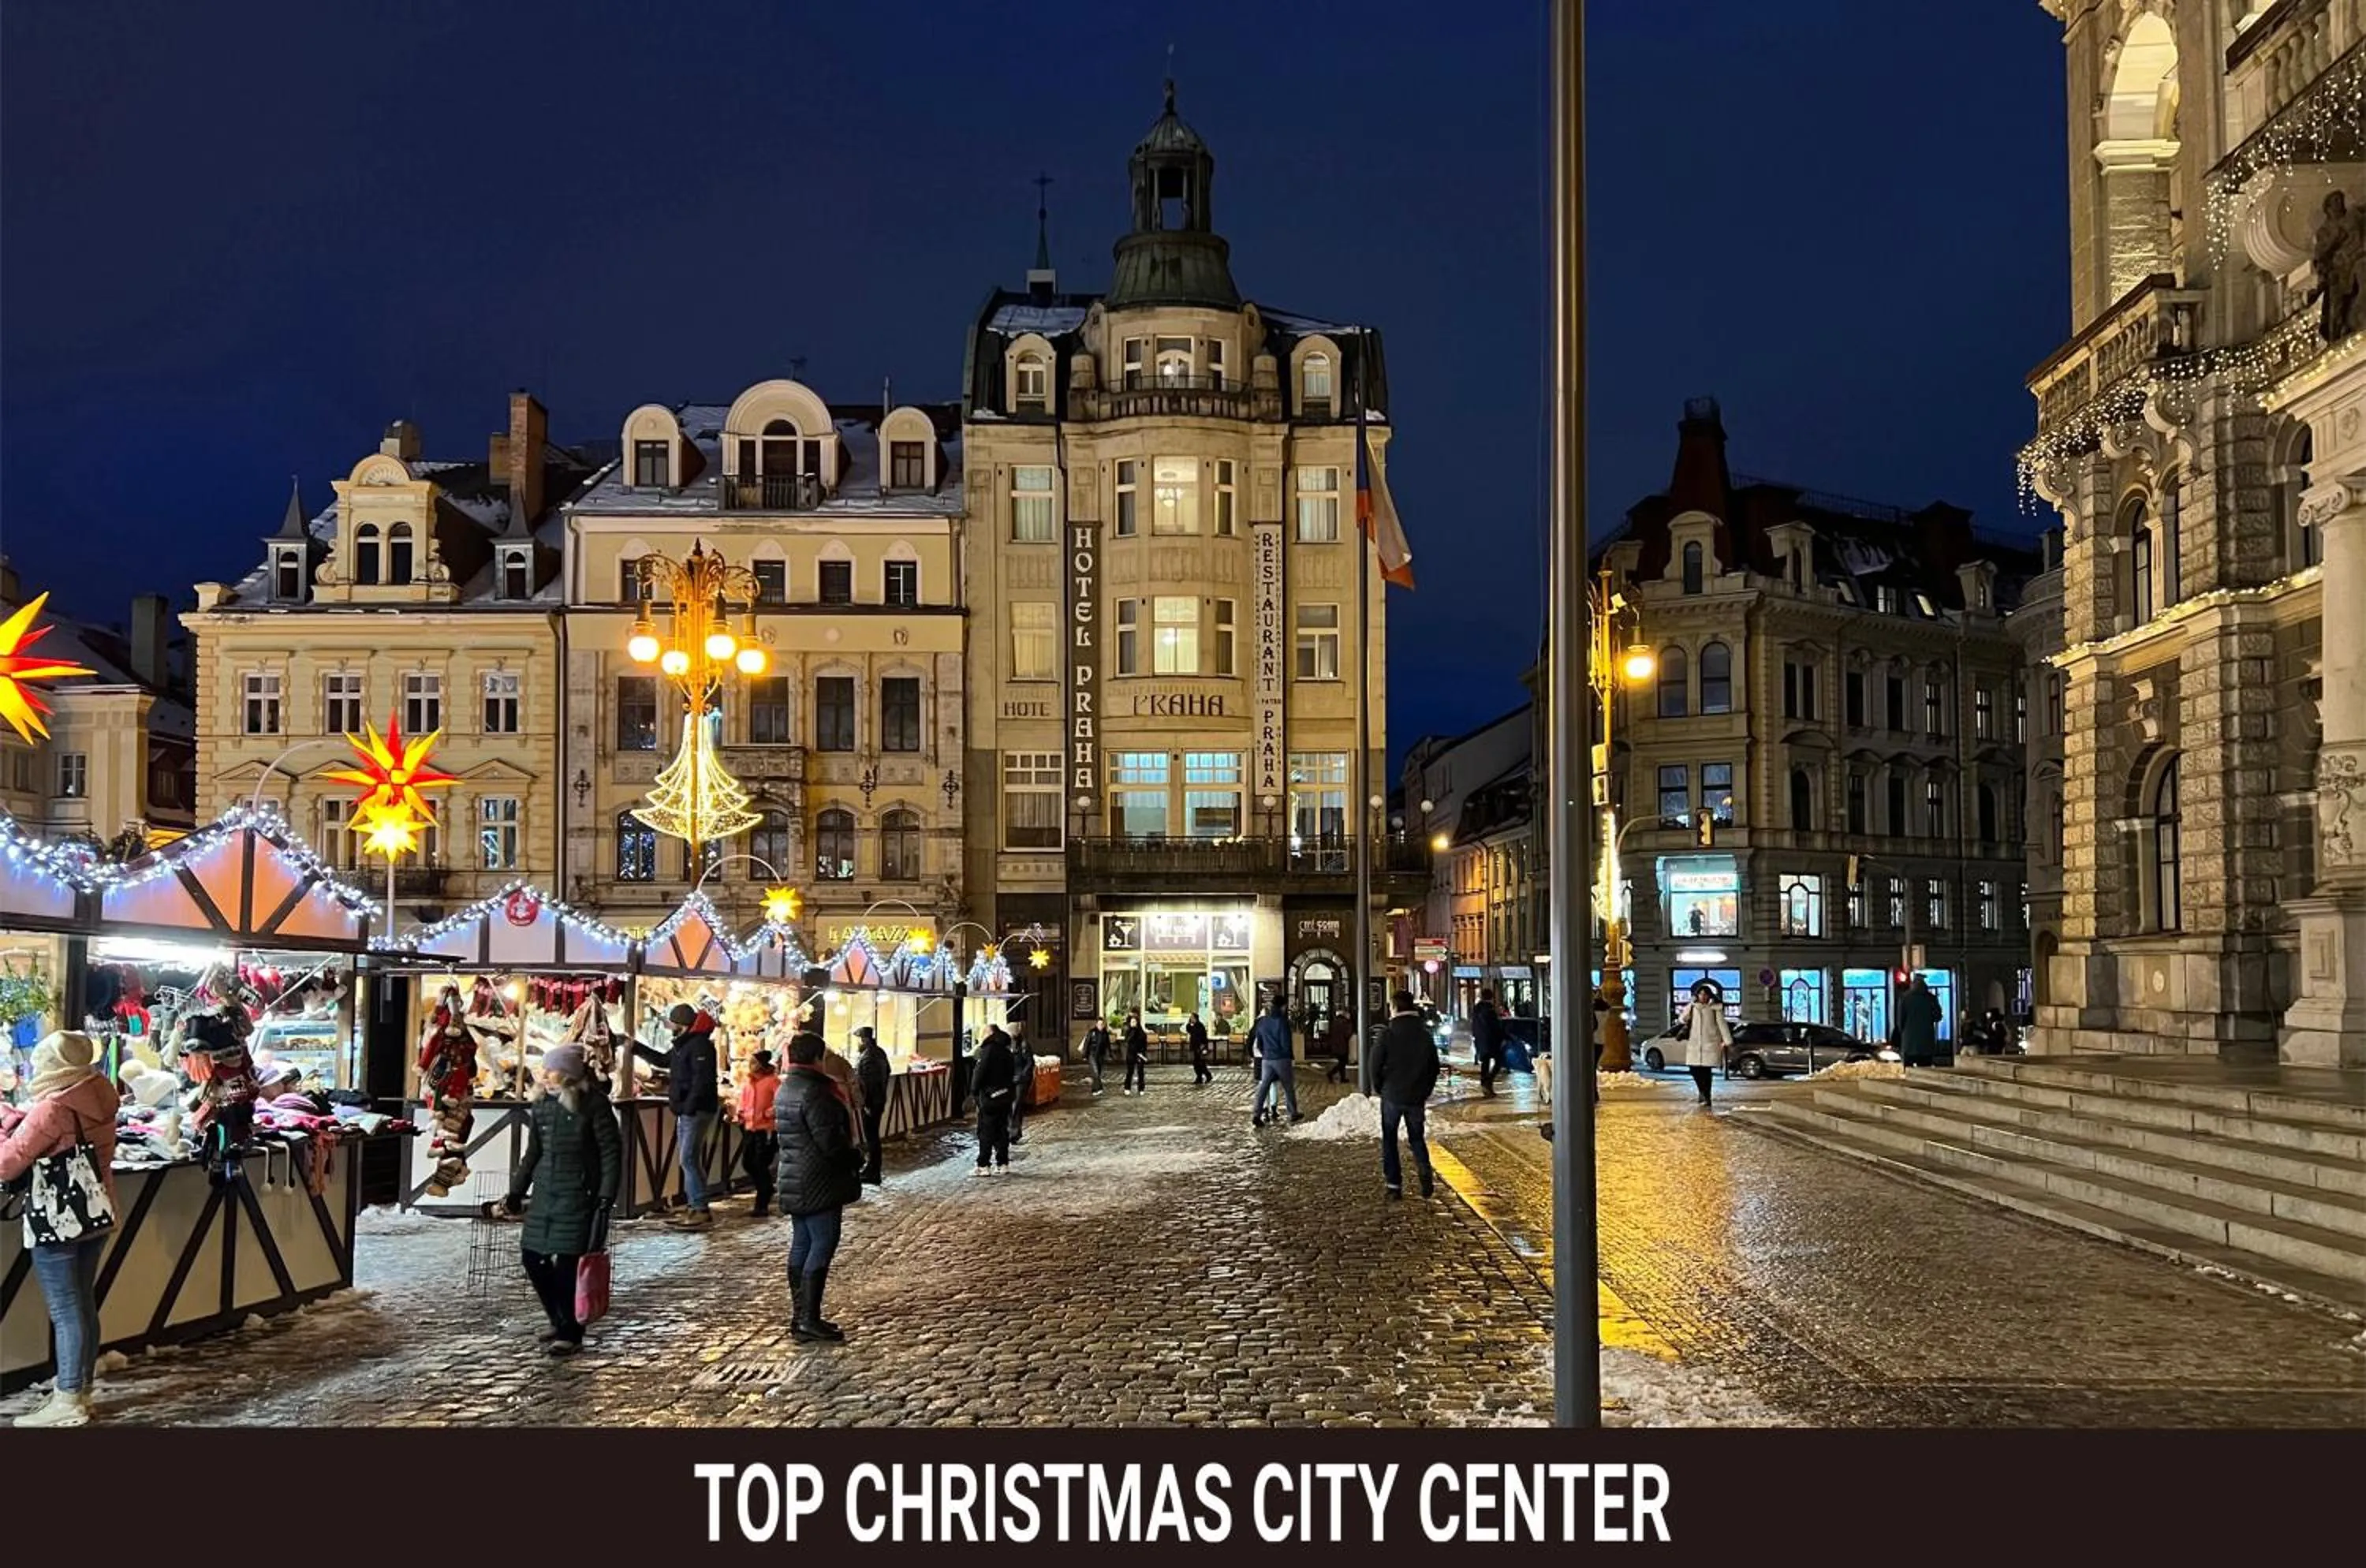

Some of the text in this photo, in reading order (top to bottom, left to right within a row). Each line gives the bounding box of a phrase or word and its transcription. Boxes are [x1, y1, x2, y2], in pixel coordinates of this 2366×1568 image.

[1074, 528, 1094, 788] HOTEL PRAHA
[1262, 532, 1274, 692] RESTAURANT
[1262, 710, 1274, 787] PRAHA
